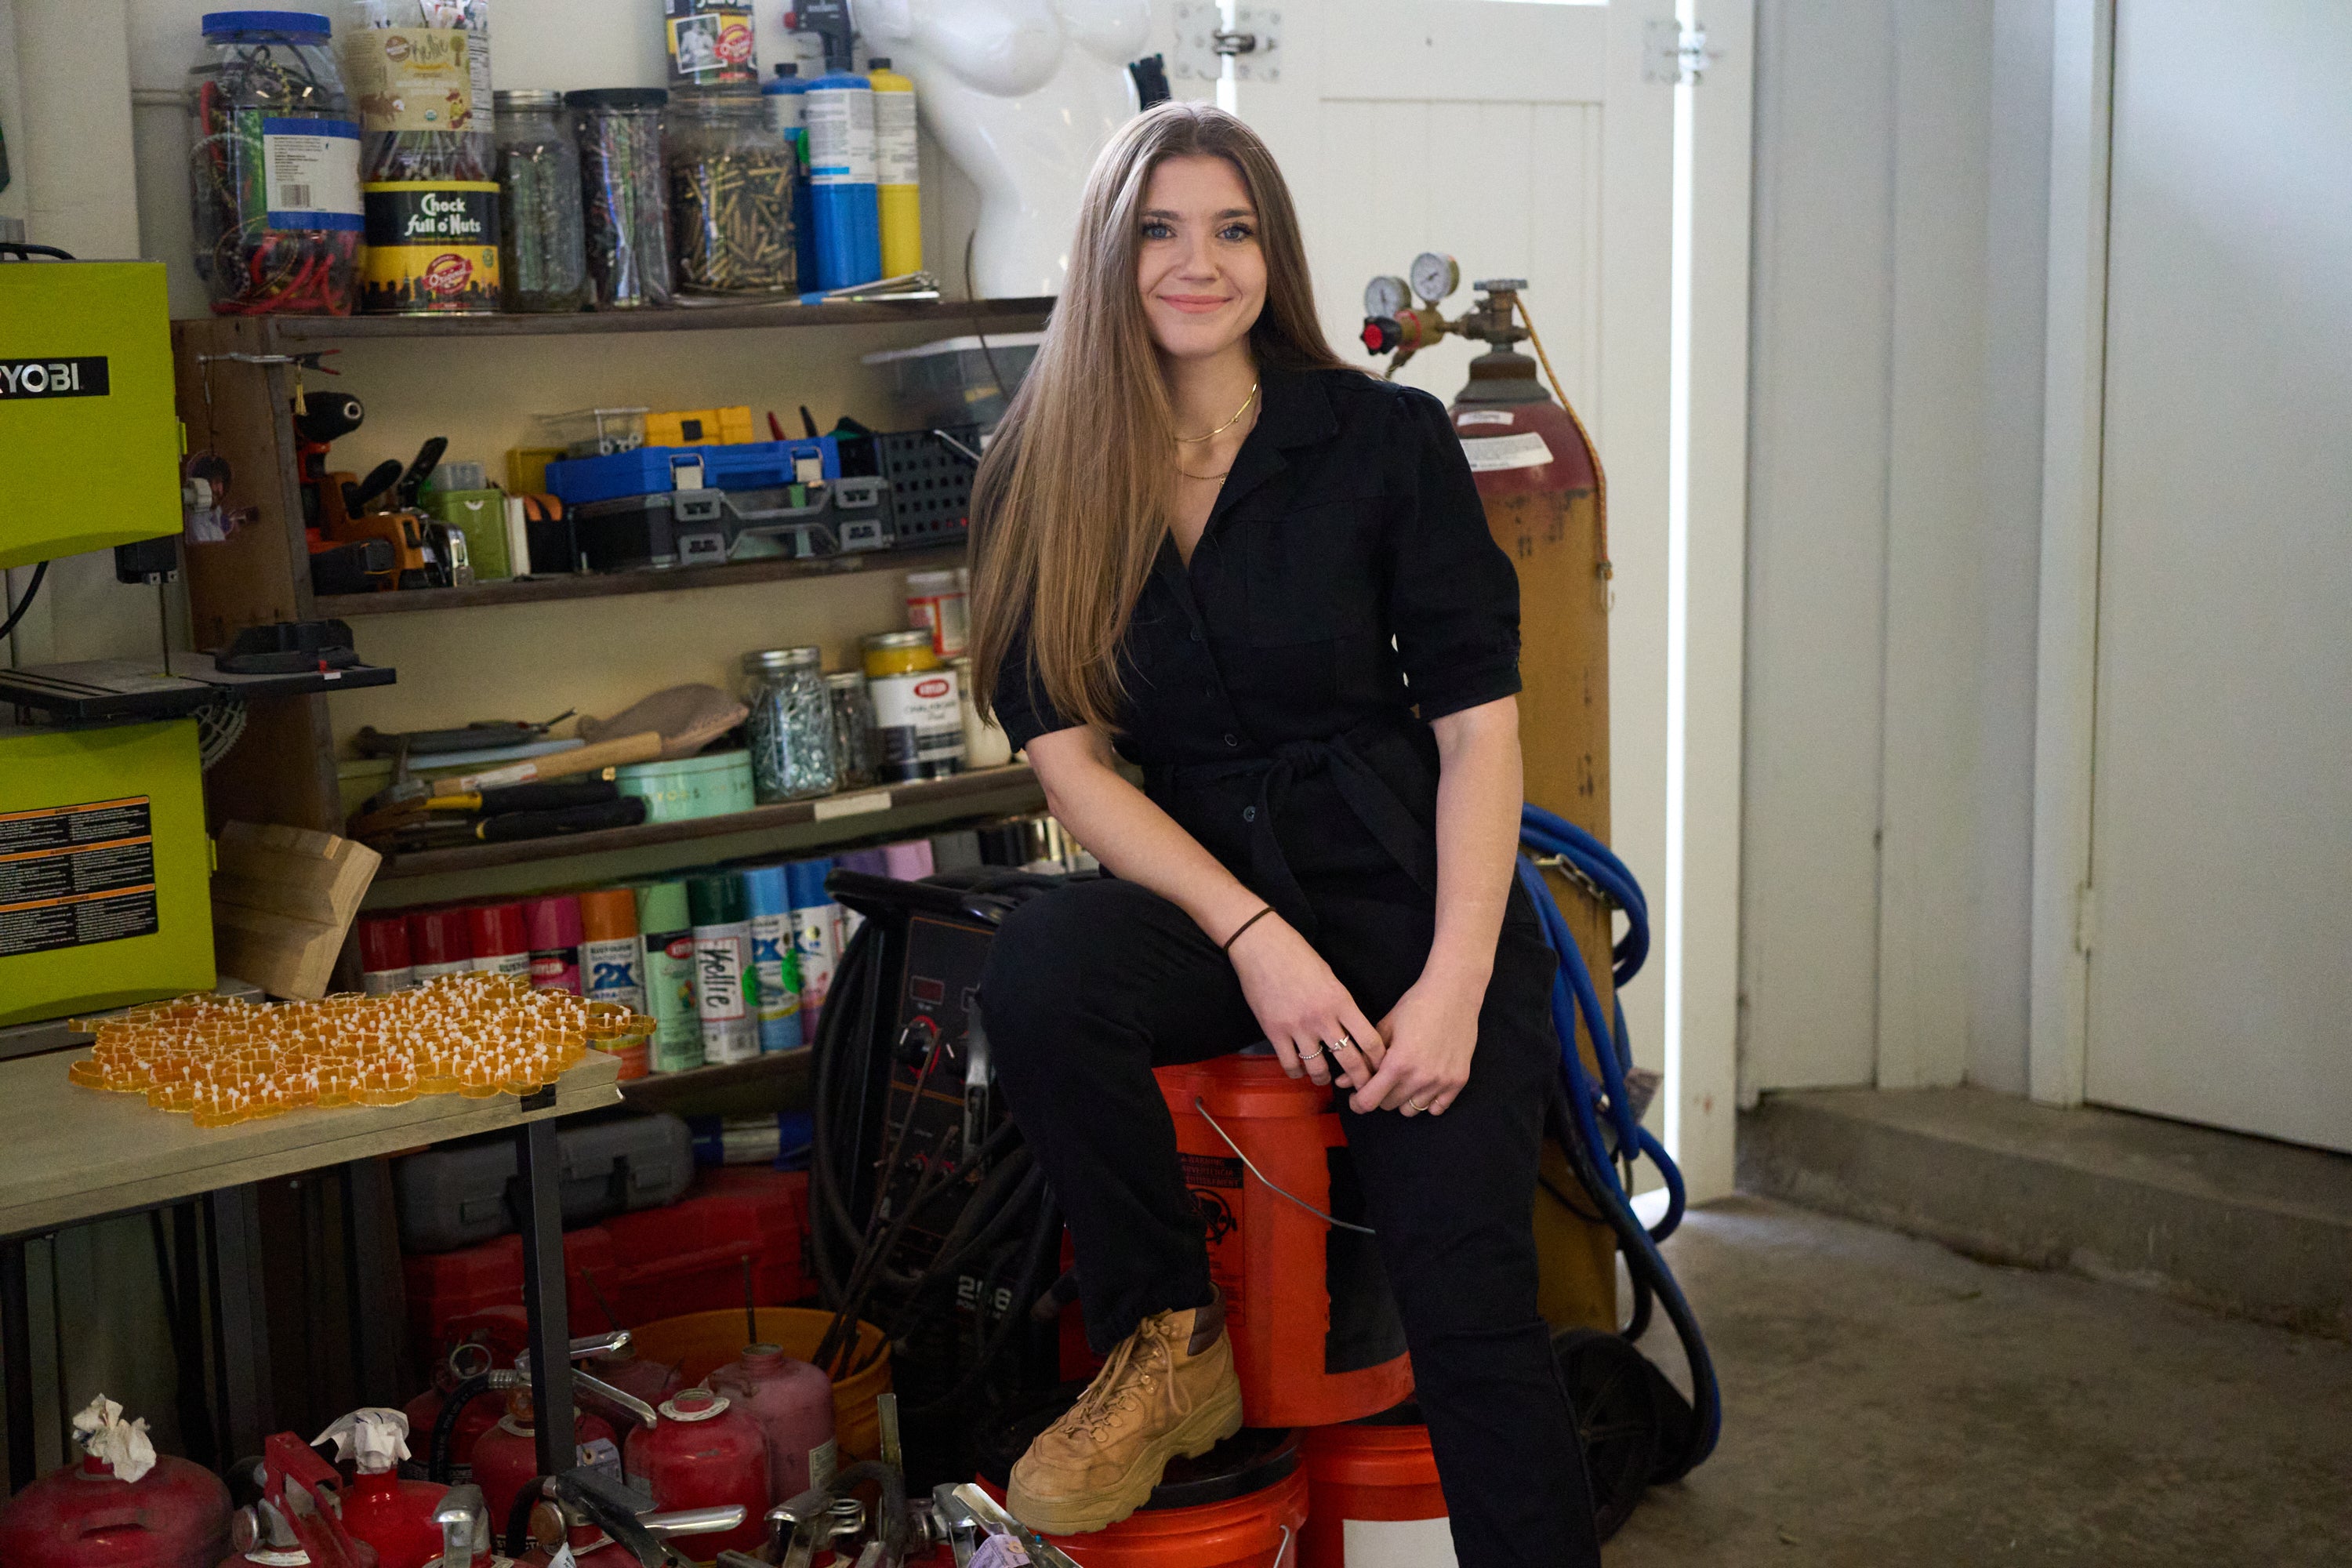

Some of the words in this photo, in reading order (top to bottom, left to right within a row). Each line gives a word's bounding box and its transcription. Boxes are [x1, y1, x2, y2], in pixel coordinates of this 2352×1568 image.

[420, 193, 466, 216] Chock
[404, 214, 436, 237] full
[449, 214, 481, 235] Nuts
[593, 962, 637, 989] 2X
